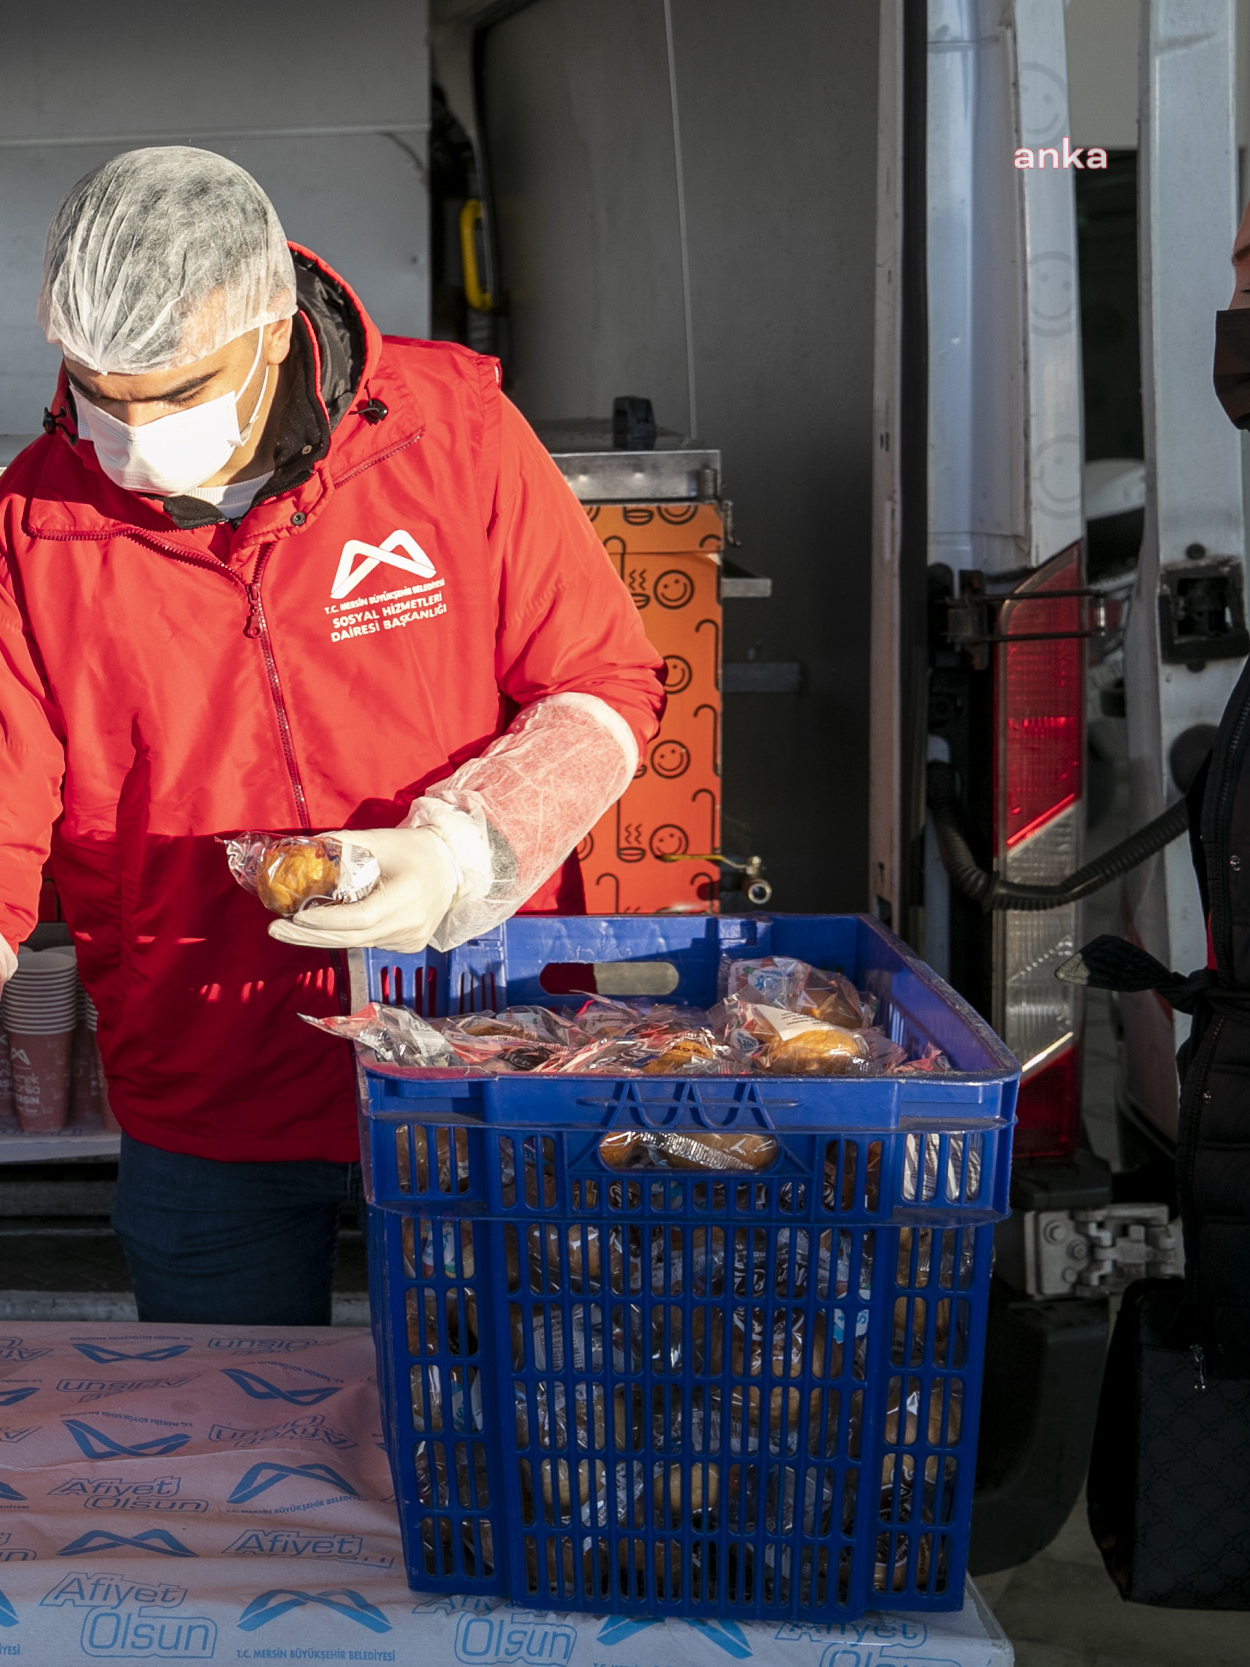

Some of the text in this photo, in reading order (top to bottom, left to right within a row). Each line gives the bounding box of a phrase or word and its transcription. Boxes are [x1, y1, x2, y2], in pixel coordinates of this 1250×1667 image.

[330, 603, 447, 643] DAİRESİ BAŞKANLIĞI
[332, 590, 442, 629] SOSYAL HİZMETLERİ
[60, 1480, 174, 1497] Afiyet
[91, 1496, 202, 1510] Olsun
[235, 1533, 354, 1556] Afiyet
[53, 1577, 179, 1610] Afiyet
[89, 1612, 209, 1651] Olsun
[462, 1617, 572, 1660] Olsun
[237, 1648, 396, 1662] T.C. MERSİN BÜYÜKŞEHİR BELEDİYESİ
